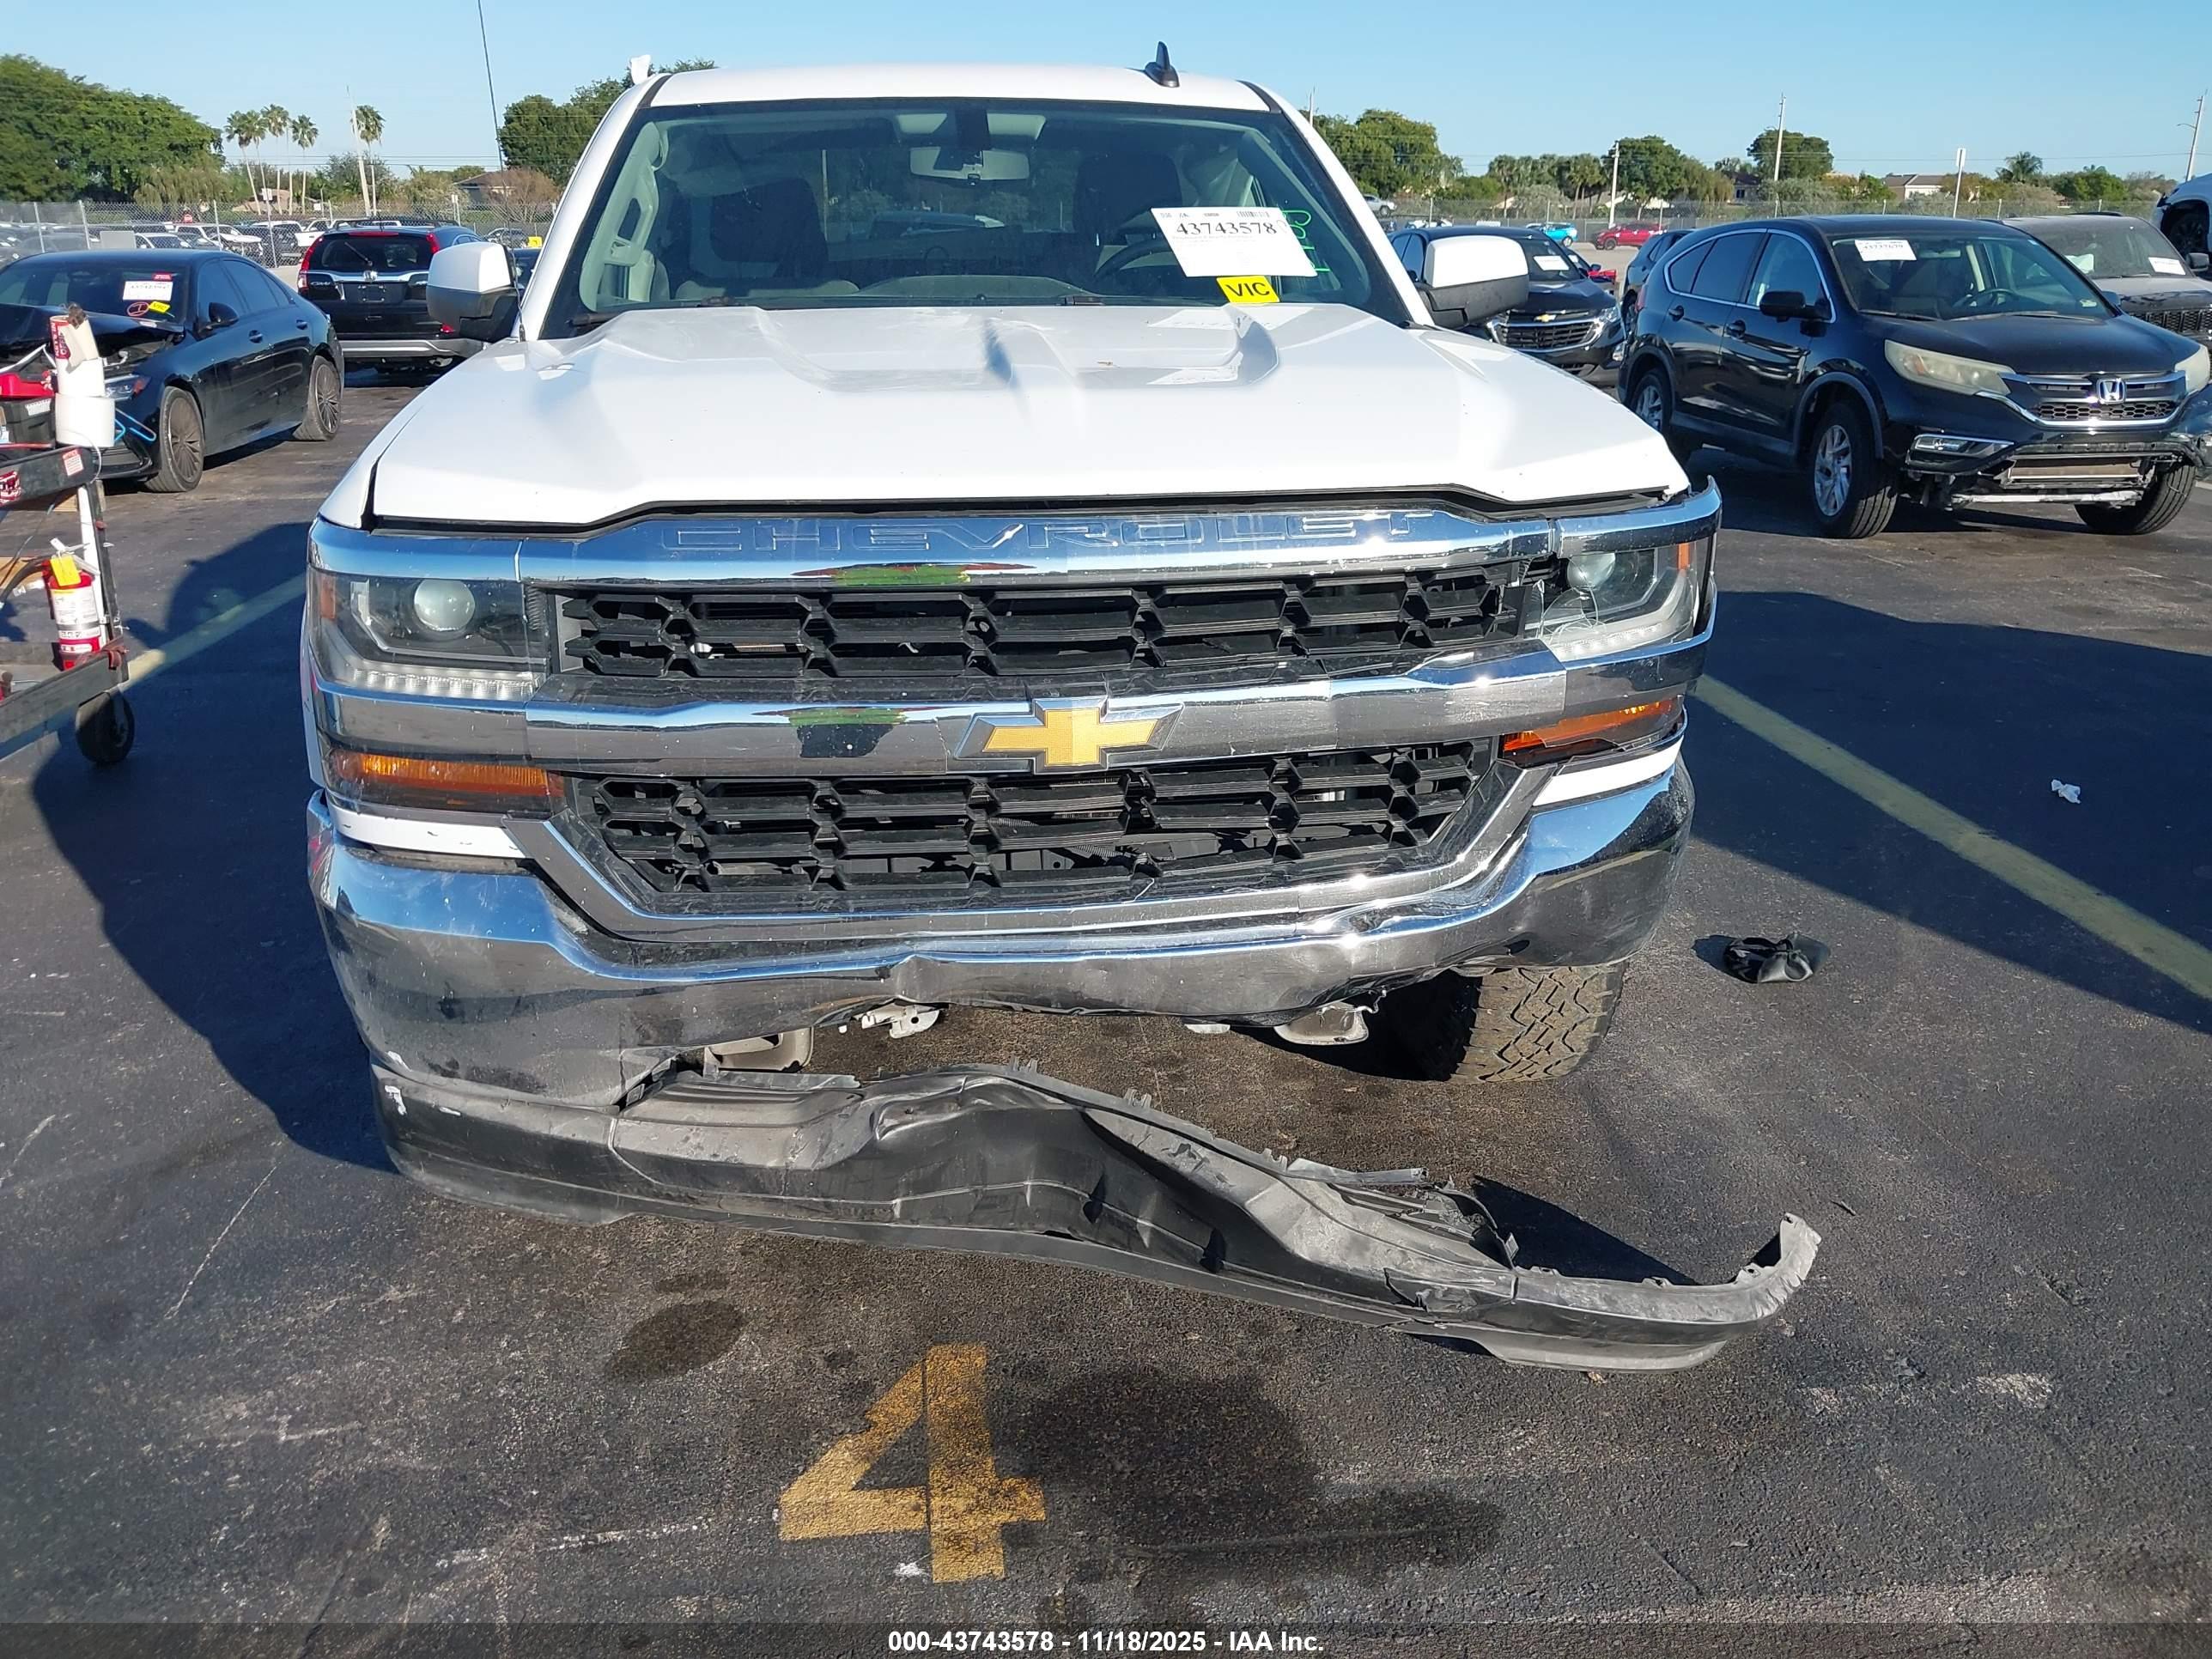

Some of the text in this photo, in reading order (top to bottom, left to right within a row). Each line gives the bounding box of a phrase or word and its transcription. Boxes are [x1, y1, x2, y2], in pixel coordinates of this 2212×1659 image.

[1176, 222, 1278, 235] 43743578
[1224, 282, 1271, 297] VIC
[661, 511, 1435, 551] CHEVROLET
[778, 1341, 1046, 1584] 4
